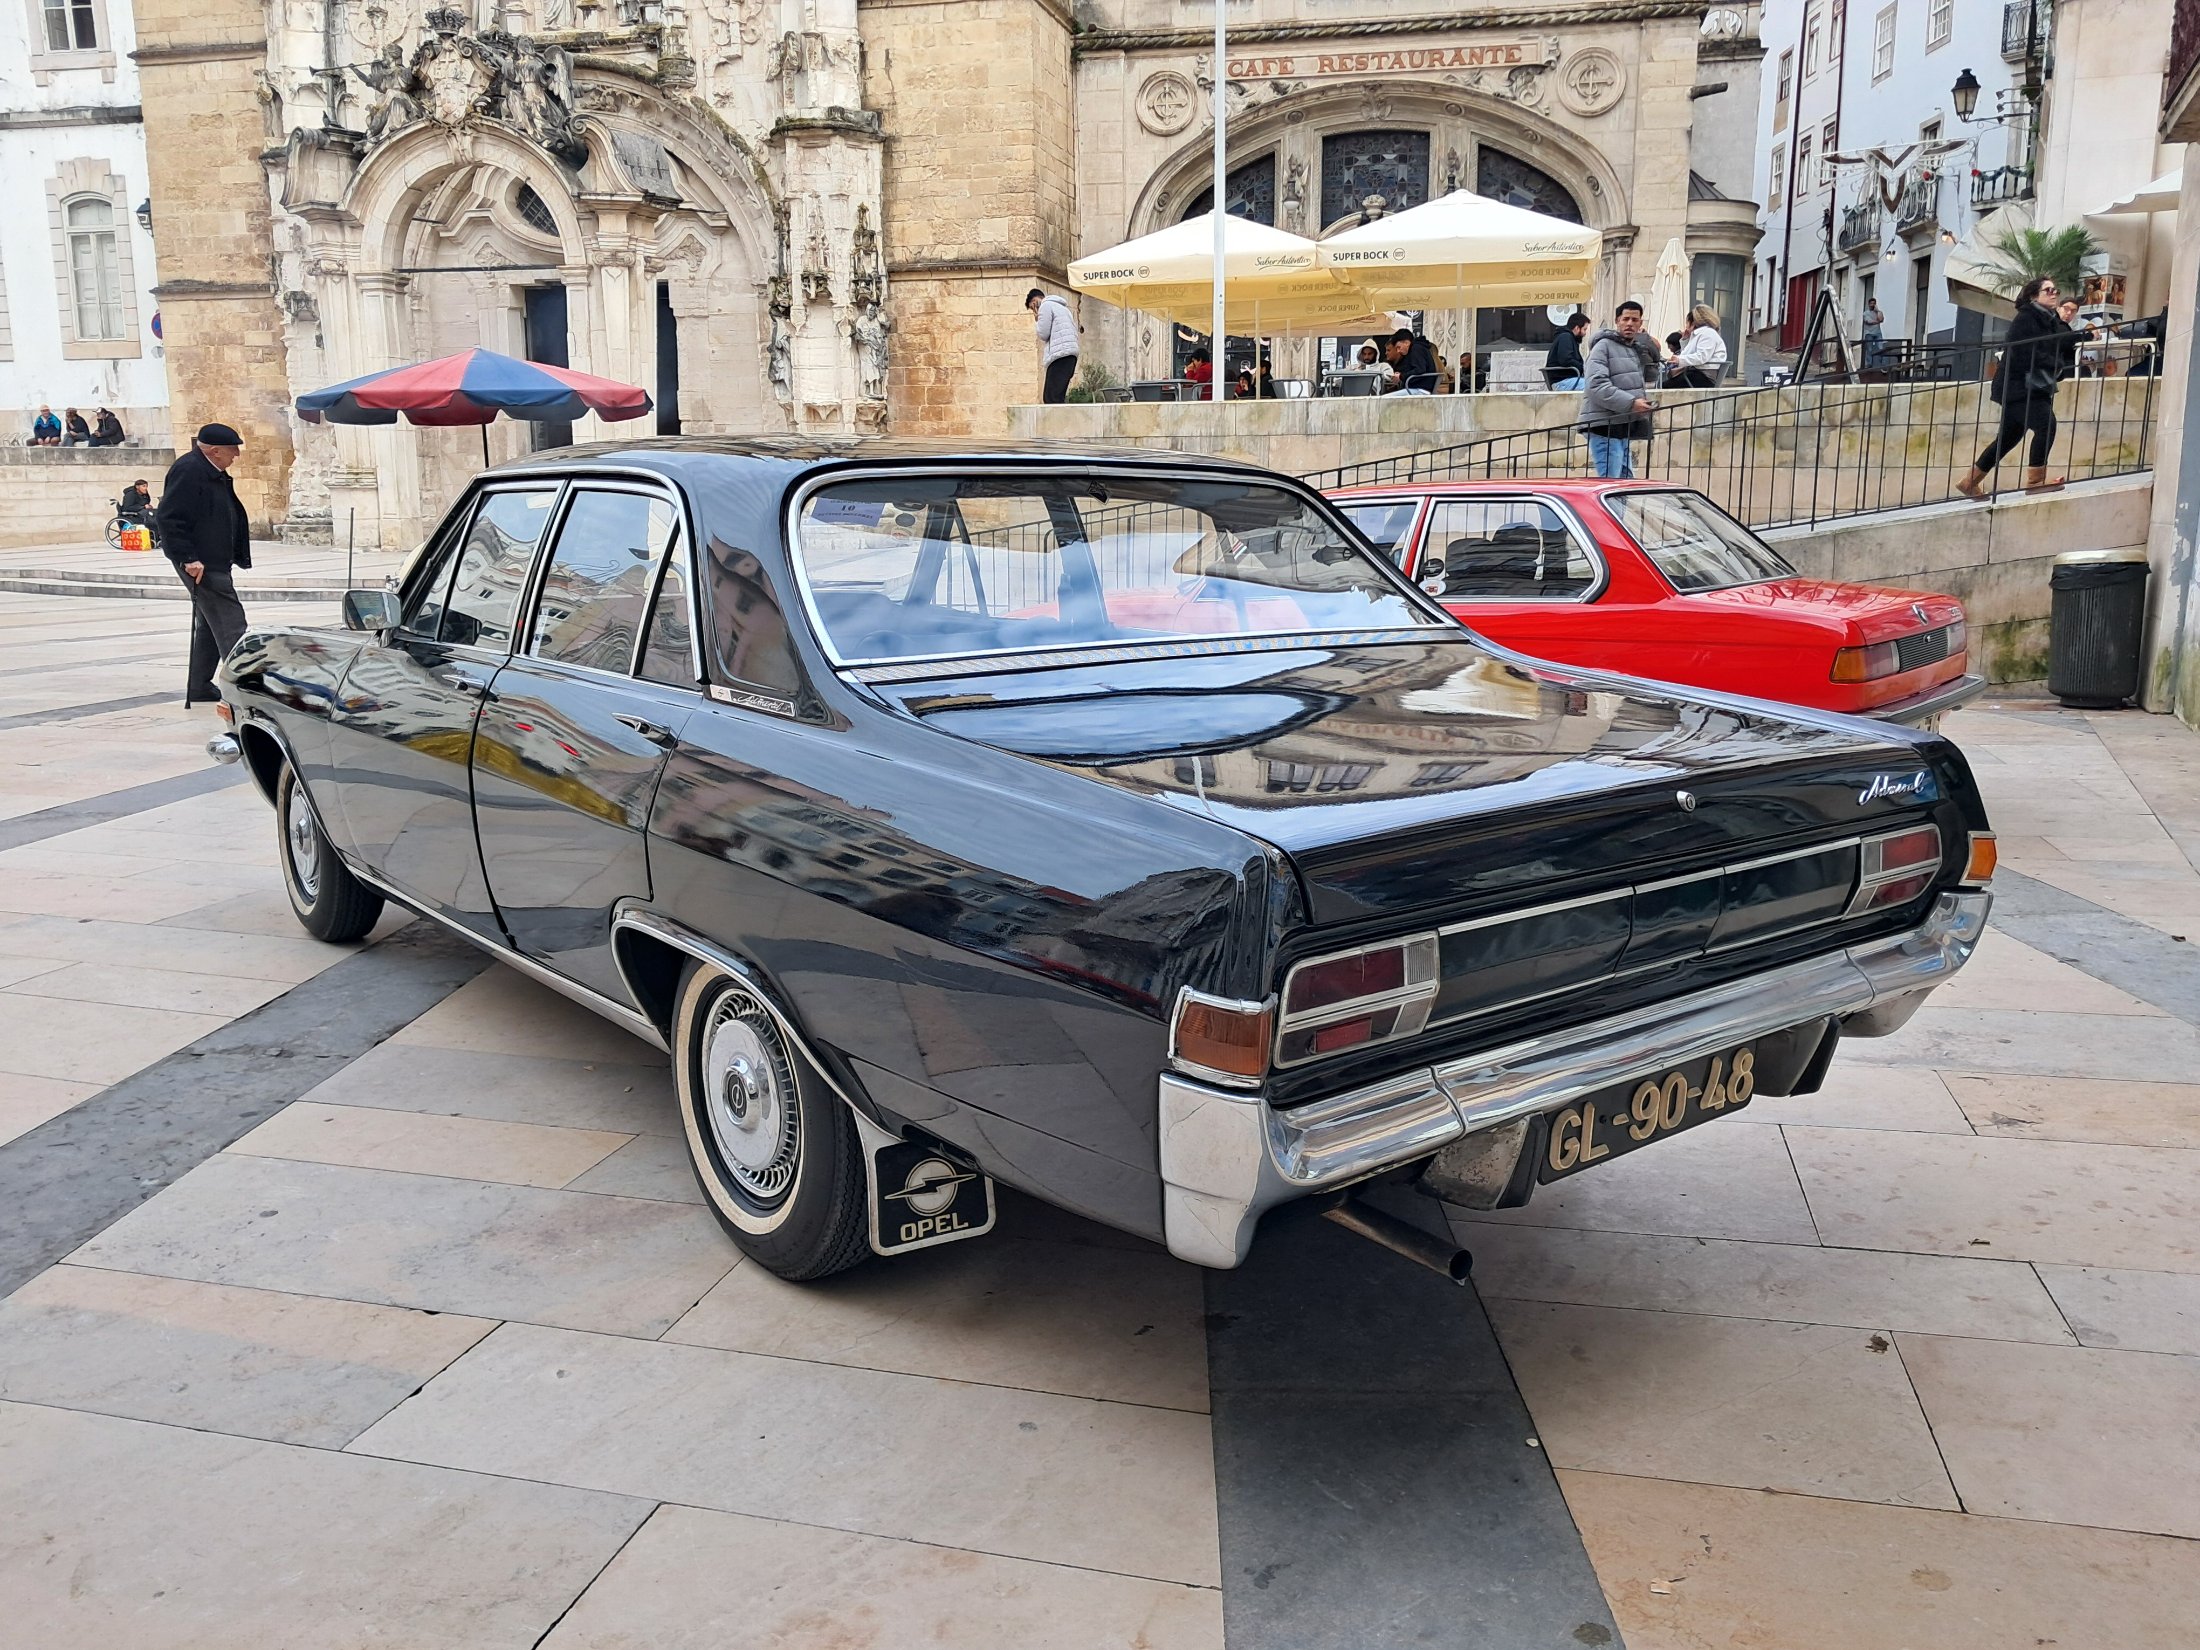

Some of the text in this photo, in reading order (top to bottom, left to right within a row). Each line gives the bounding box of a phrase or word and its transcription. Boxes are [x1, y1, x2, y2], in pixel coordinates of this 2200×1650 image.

[1227, 45, 1522, 78] CAFÉ RESTAURANTE
[1522, 242, 1547, 253] Sabor
[1254, 256, 1277, 266] Sabor
[1332, 251, 1361, 261] SUPER
[1363, 250, 1389, 260] BOCK
[1083, 271, 1110, 281] SUPER
[1111, 268, 1135, 278] BOCK
[1549, 1047, 1755, 1171] GL-90-48
[900, 1212, 969, 1242] OPEL
